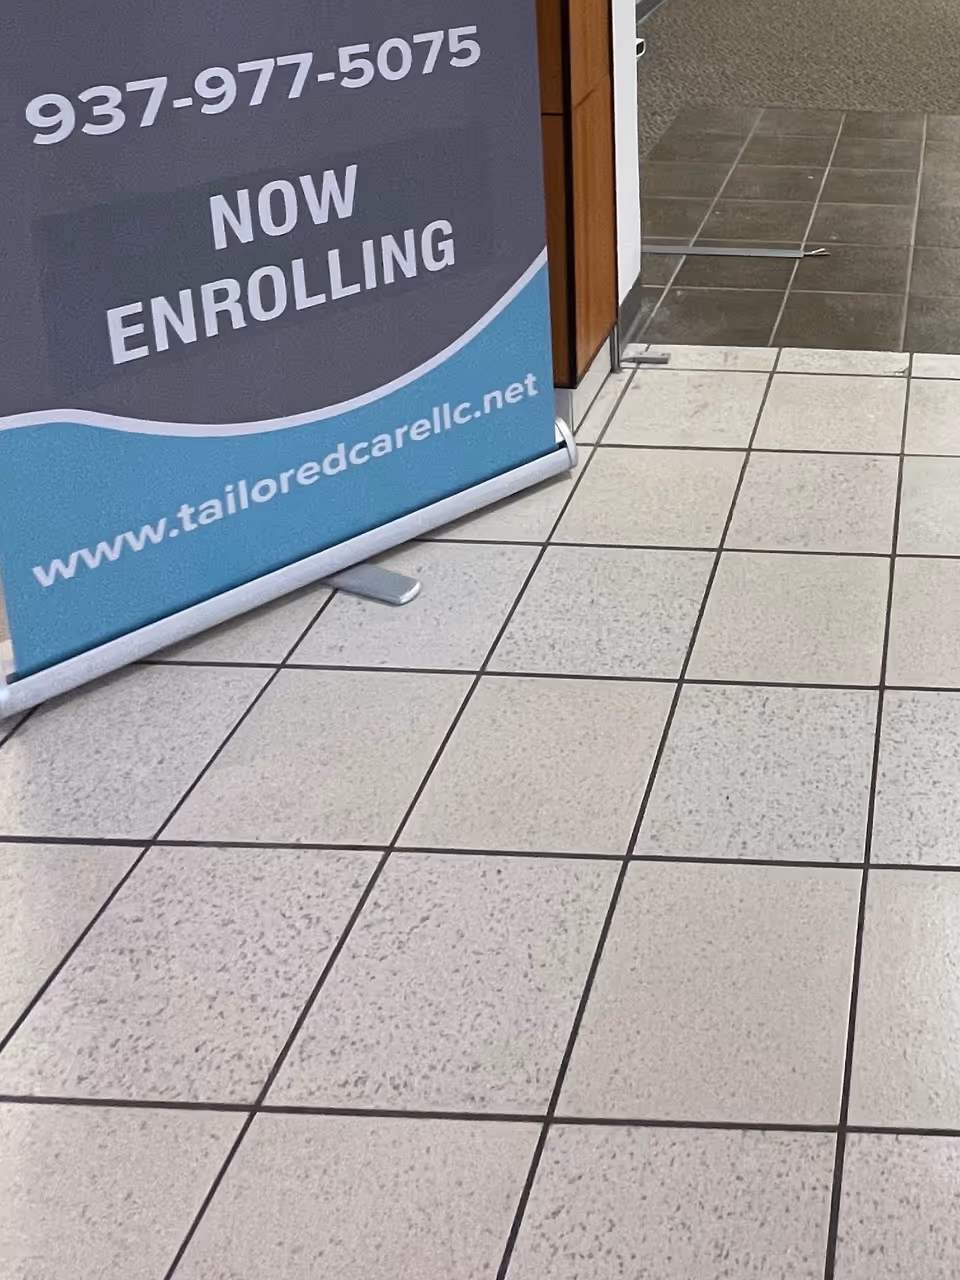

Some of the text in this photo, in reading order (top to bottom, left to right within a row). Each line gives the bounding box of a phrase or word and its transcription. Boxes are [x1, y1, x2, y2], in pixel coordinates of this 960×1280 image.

[25, 25, 481, 145] 937-977-5075
[209, 164, 358, 250] NOW
[106, 219, 455, 365] ENROLLING
[32, 372, 539, 587] www.tailoredcarellc.net
